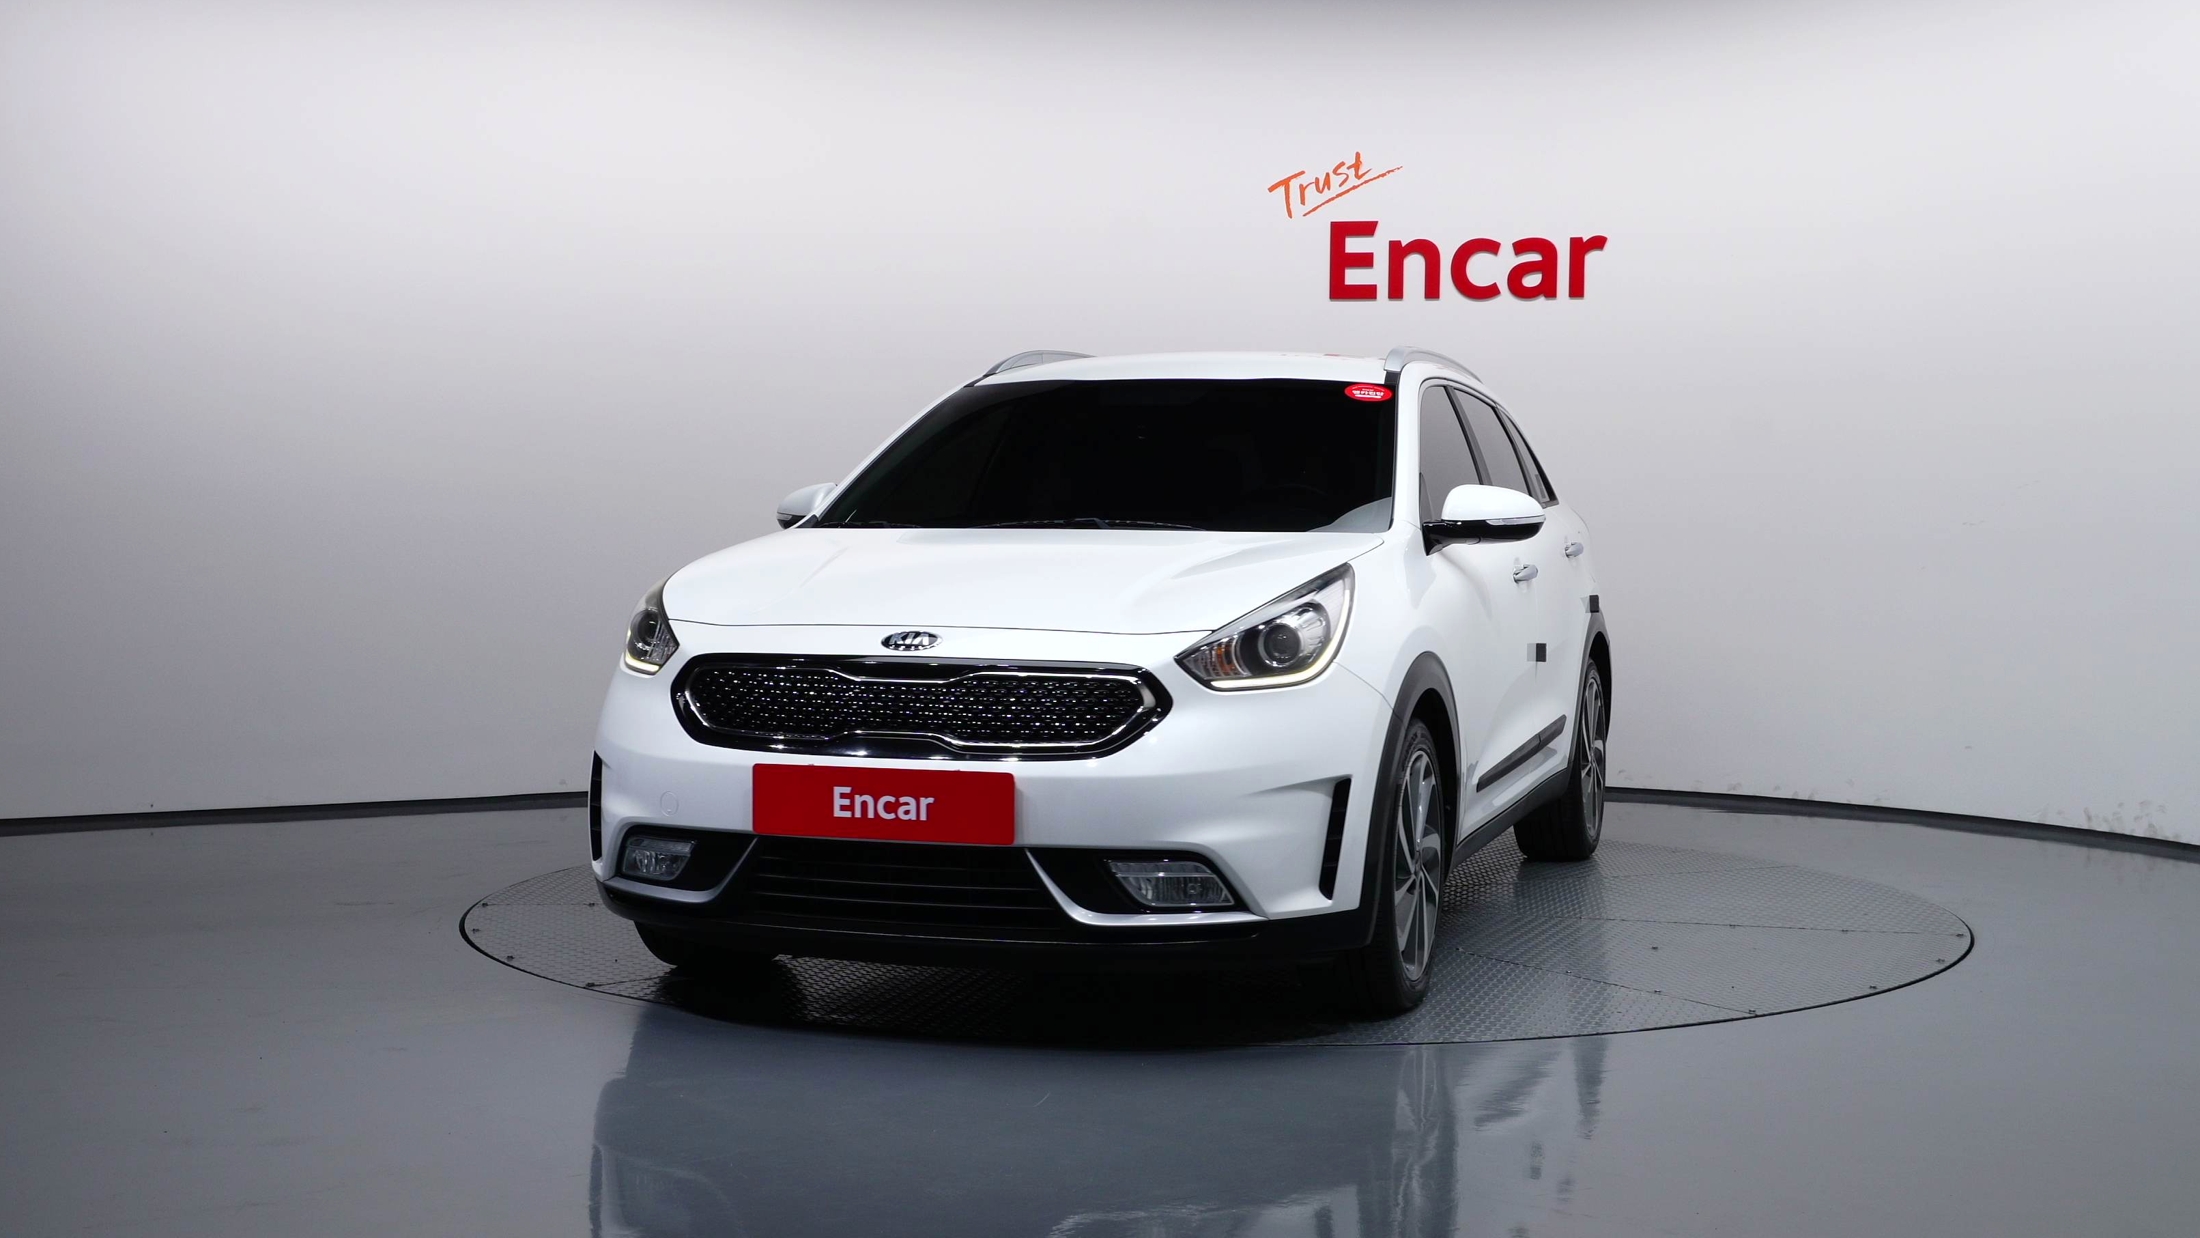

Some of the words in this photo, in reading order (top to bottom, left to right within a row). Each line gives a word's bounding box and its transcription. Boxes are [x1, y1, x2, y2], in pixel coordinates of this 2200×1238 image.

[1268, 152, 1372, 219] Trust
[1329, 221, 1609, 301] Encar
[888, 632, 930, 645] KIA
[833, 786, 935, 821] Encar
